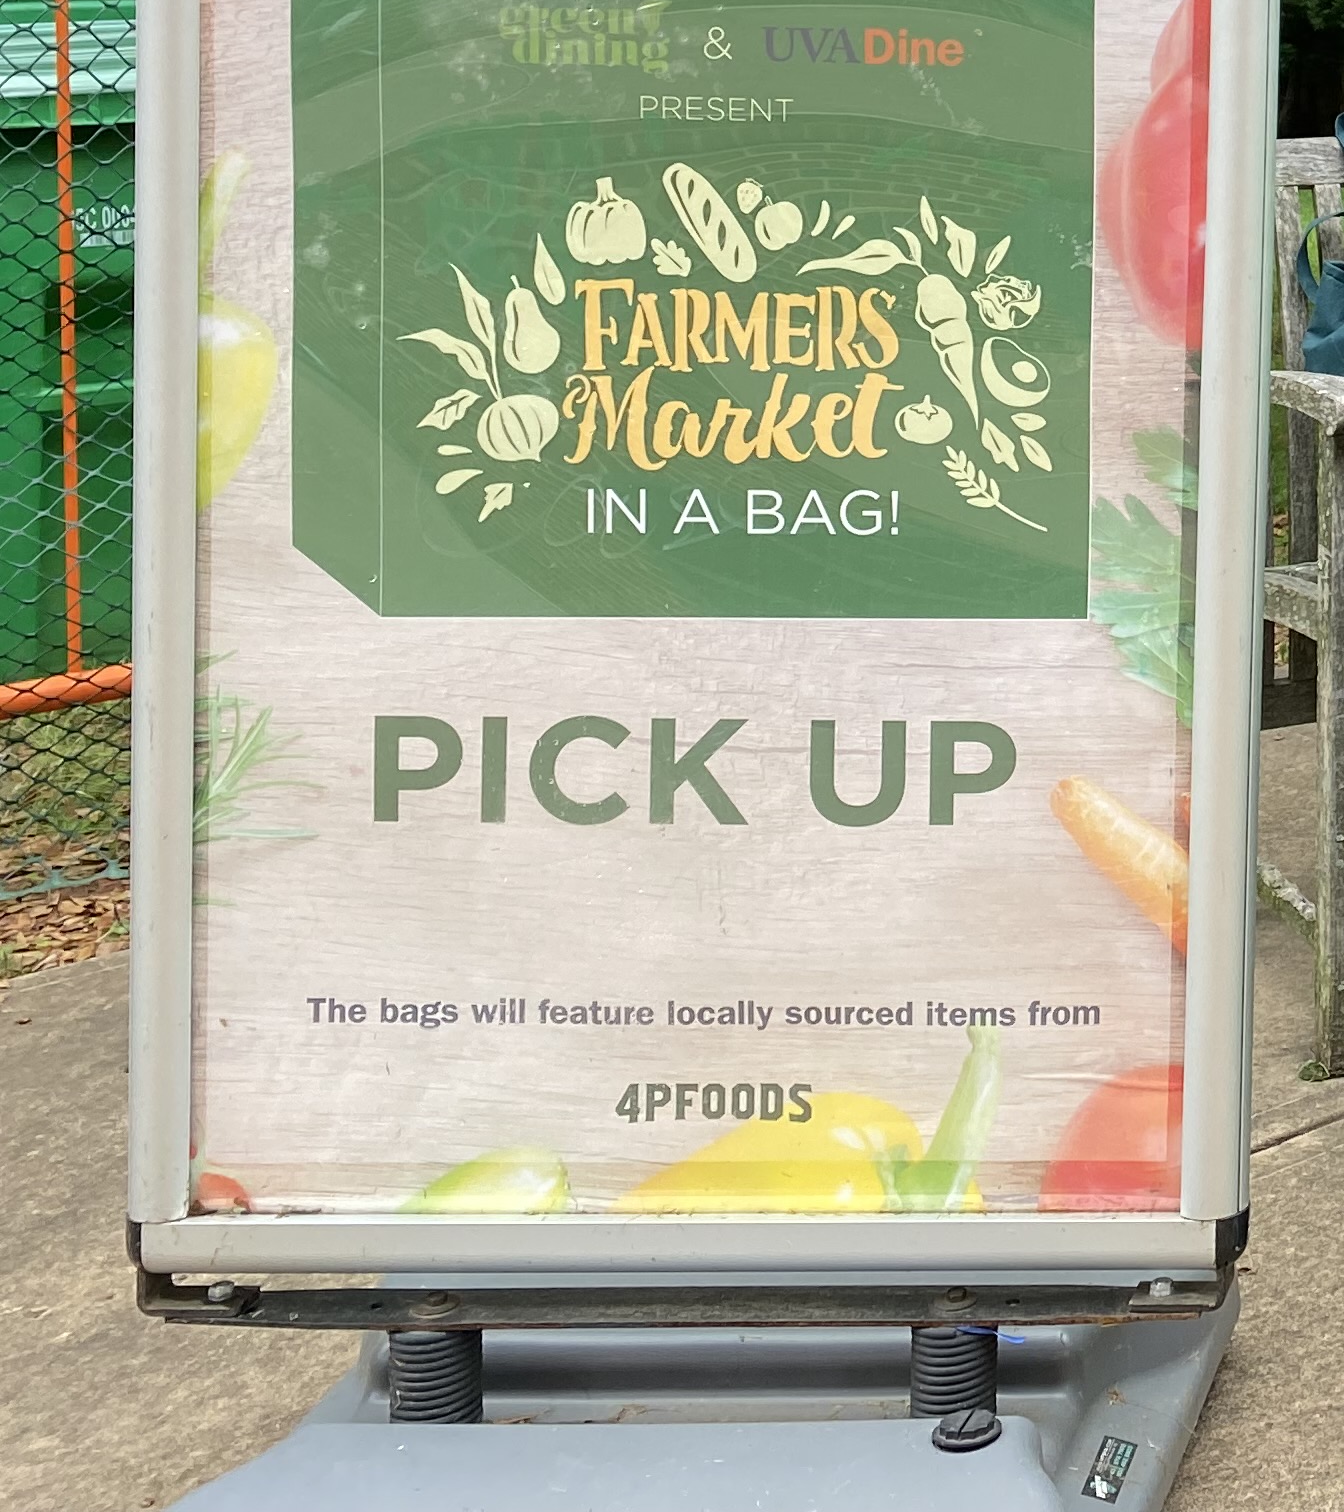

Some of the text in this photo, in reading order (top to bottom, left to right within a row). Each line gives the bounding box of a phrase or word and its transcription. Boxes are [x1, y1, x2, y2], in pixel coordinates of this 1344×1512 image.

[499, 3, 640, 39] green
[512, 31, 670, 75] dining
[703, 26, 733, 60] &
[639, 96, 794, 122] PRESENT
[575, 278, 900, 372] FARMERS
[562, 367, 904, 471] Market
[586, 489, 900, 536] IN A BAG!
[374, 715, 1017, 828] PICK UP
[306, 997, 1101, 1031] The bags will feature locally sourced items from
[614, 1082, 813, 1124] 4PFOODS
